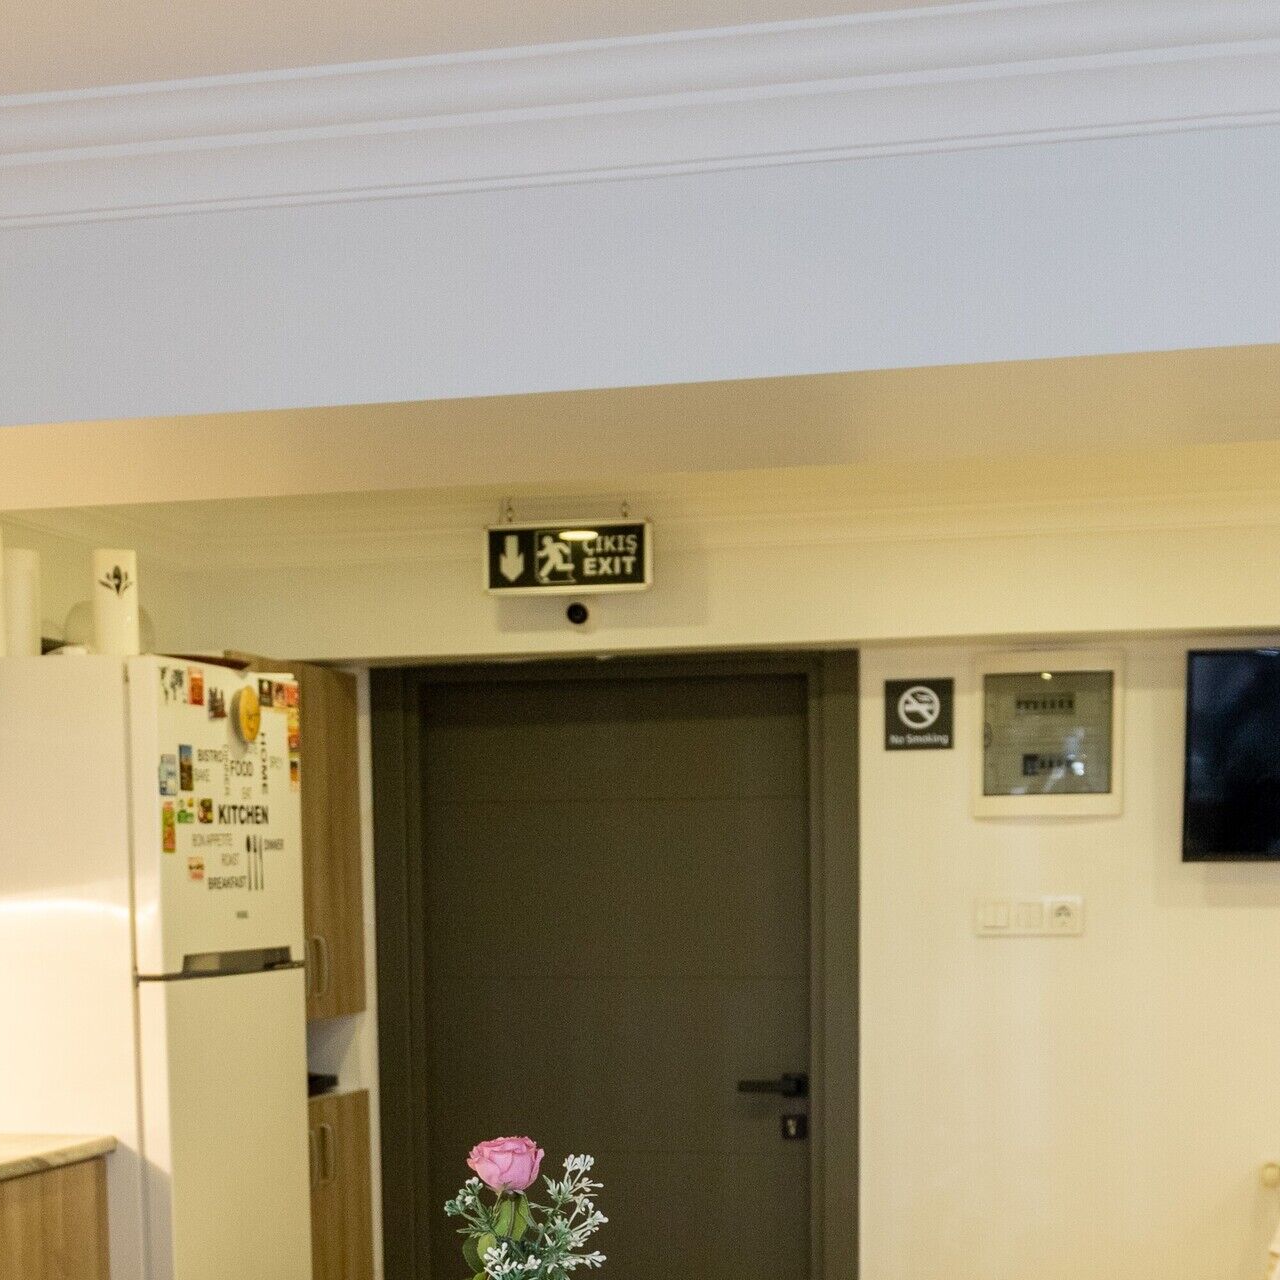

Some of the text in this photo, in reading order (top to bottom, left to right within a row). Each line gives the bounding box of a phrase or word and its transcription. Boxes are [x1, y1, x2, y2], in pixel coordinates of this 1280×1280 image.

[583, 556, 637, 576] EXIT
[905, 733, 949, 746] Smoking
[197, 749, 224, 762] BISTRO
[260, 732, 269, 795] HOME
[230, 760, 254, 776] FOOD
[218, 804, 269, 824] KITCHEN
[208, 875, 247, 890] BREAKFAST
